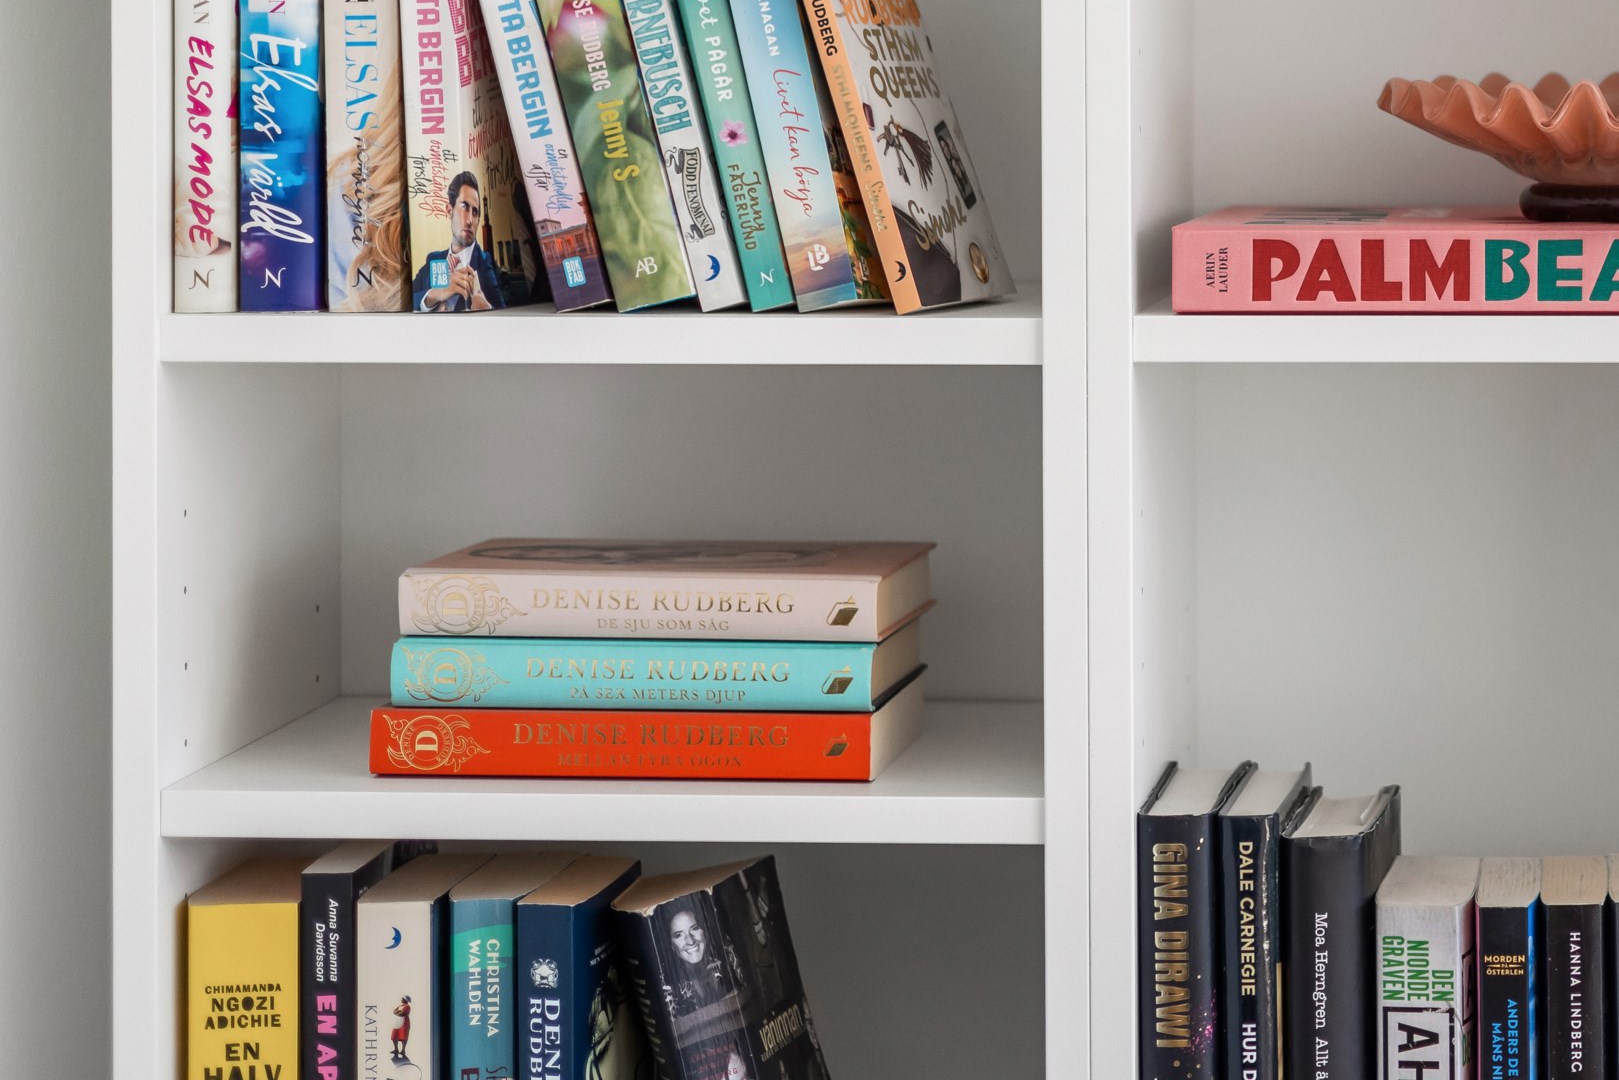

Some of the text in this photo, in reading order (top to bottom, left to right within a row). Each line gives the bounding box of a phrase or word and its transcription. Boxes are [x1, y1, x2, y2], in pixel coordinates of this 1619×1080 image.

[418, 32, 446, 135] BERGIN
[507, 35, 553, 139] BERGIN
[870, 66, 941, 107] QUEENS
[727, 164, 757, 251] FAGERLUND
[1206, 252, 1215, 288] AERIN
[1219, 247, 1228, 293] LAUDER
[1252, 238, 1470, 302] PALM
[531, 587, 795, 614] DENISE RUDBERG
[597, 619, 729, 632] DE SJU SOM SÅG
[526, 657, 791, 683] DENISE RUDBERG
[570, 686, 746, 704] PÅ SEX METERS DJUP
[513, 723, 790, 747] DENISE RUDBERG
[315, 922, 326, 982] Davidsson
[328, 898, 339, 982] Anna Suvanna
[1152, 843, 1190, 1048] GINA DIRAWI
[1238, 841, 1257, 1064] DALE CARNEGIE HUR
[1484, 955, 1525, 963] MORDEN
[205, 984, 282, 994] CHIMAMANDA
[468, 939, 484, 1026] WAHLDÉN
[486, 938, 500, 1038] CHRISTINA
[1382, 936, 1405, 1001] GRAVEN
[1407, 941, 1429, 1001] NIONDE
[1432, 970, 1454, 1001] DEN
[205, 1014, 281, 1030] ADICHIE
[211, 996, 275, 1013] NGOZI
[1570, 932, 1582, 1073] HANNA LINDBERG
[225, 1042, 260, 1062] EN
[1492, 1023, 1505, 1062] MÅNS
